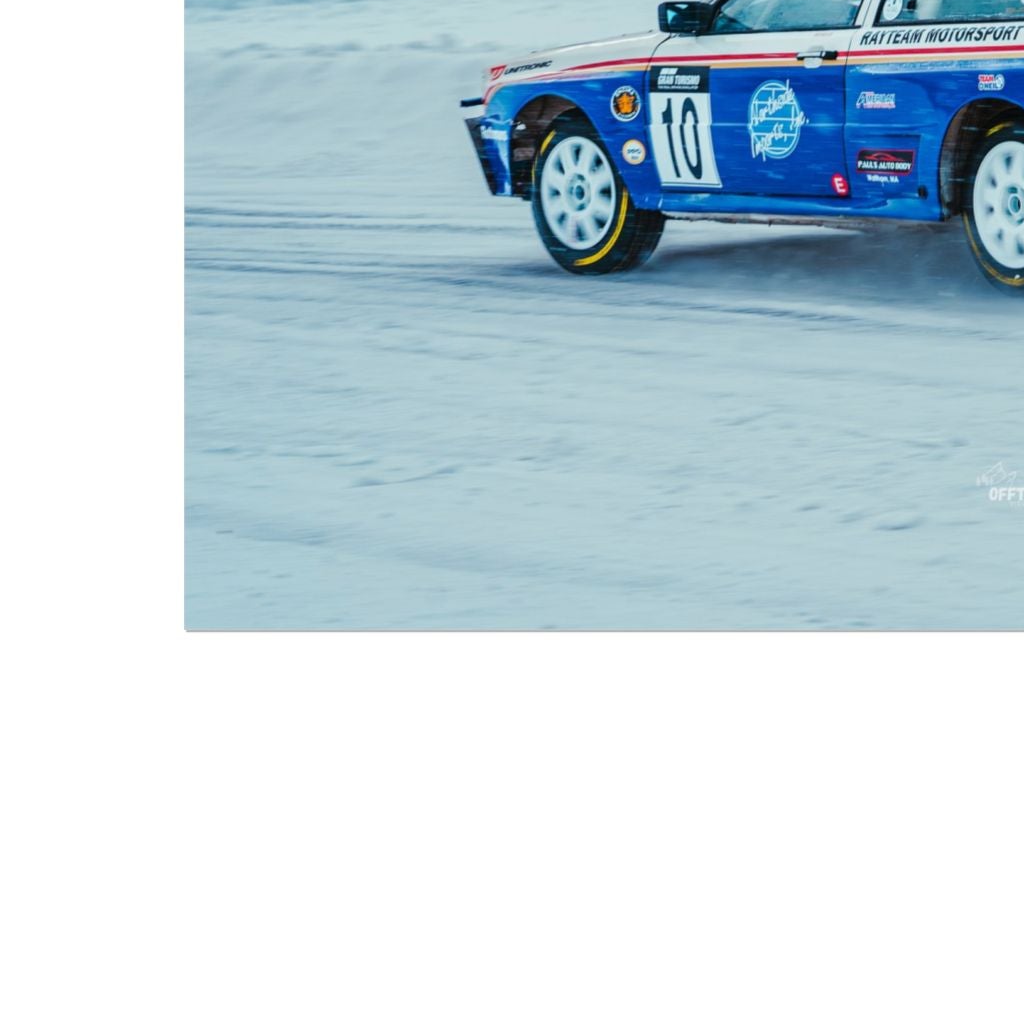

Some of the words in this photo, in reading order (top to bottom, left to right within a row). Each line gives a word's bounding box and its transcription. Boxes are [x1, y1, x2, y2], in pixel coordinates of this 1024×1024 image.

[860, 29, 925, 45] RAYTEAM
[662, 97, 702, 180] 10
[834, 177, 845, 192] E
